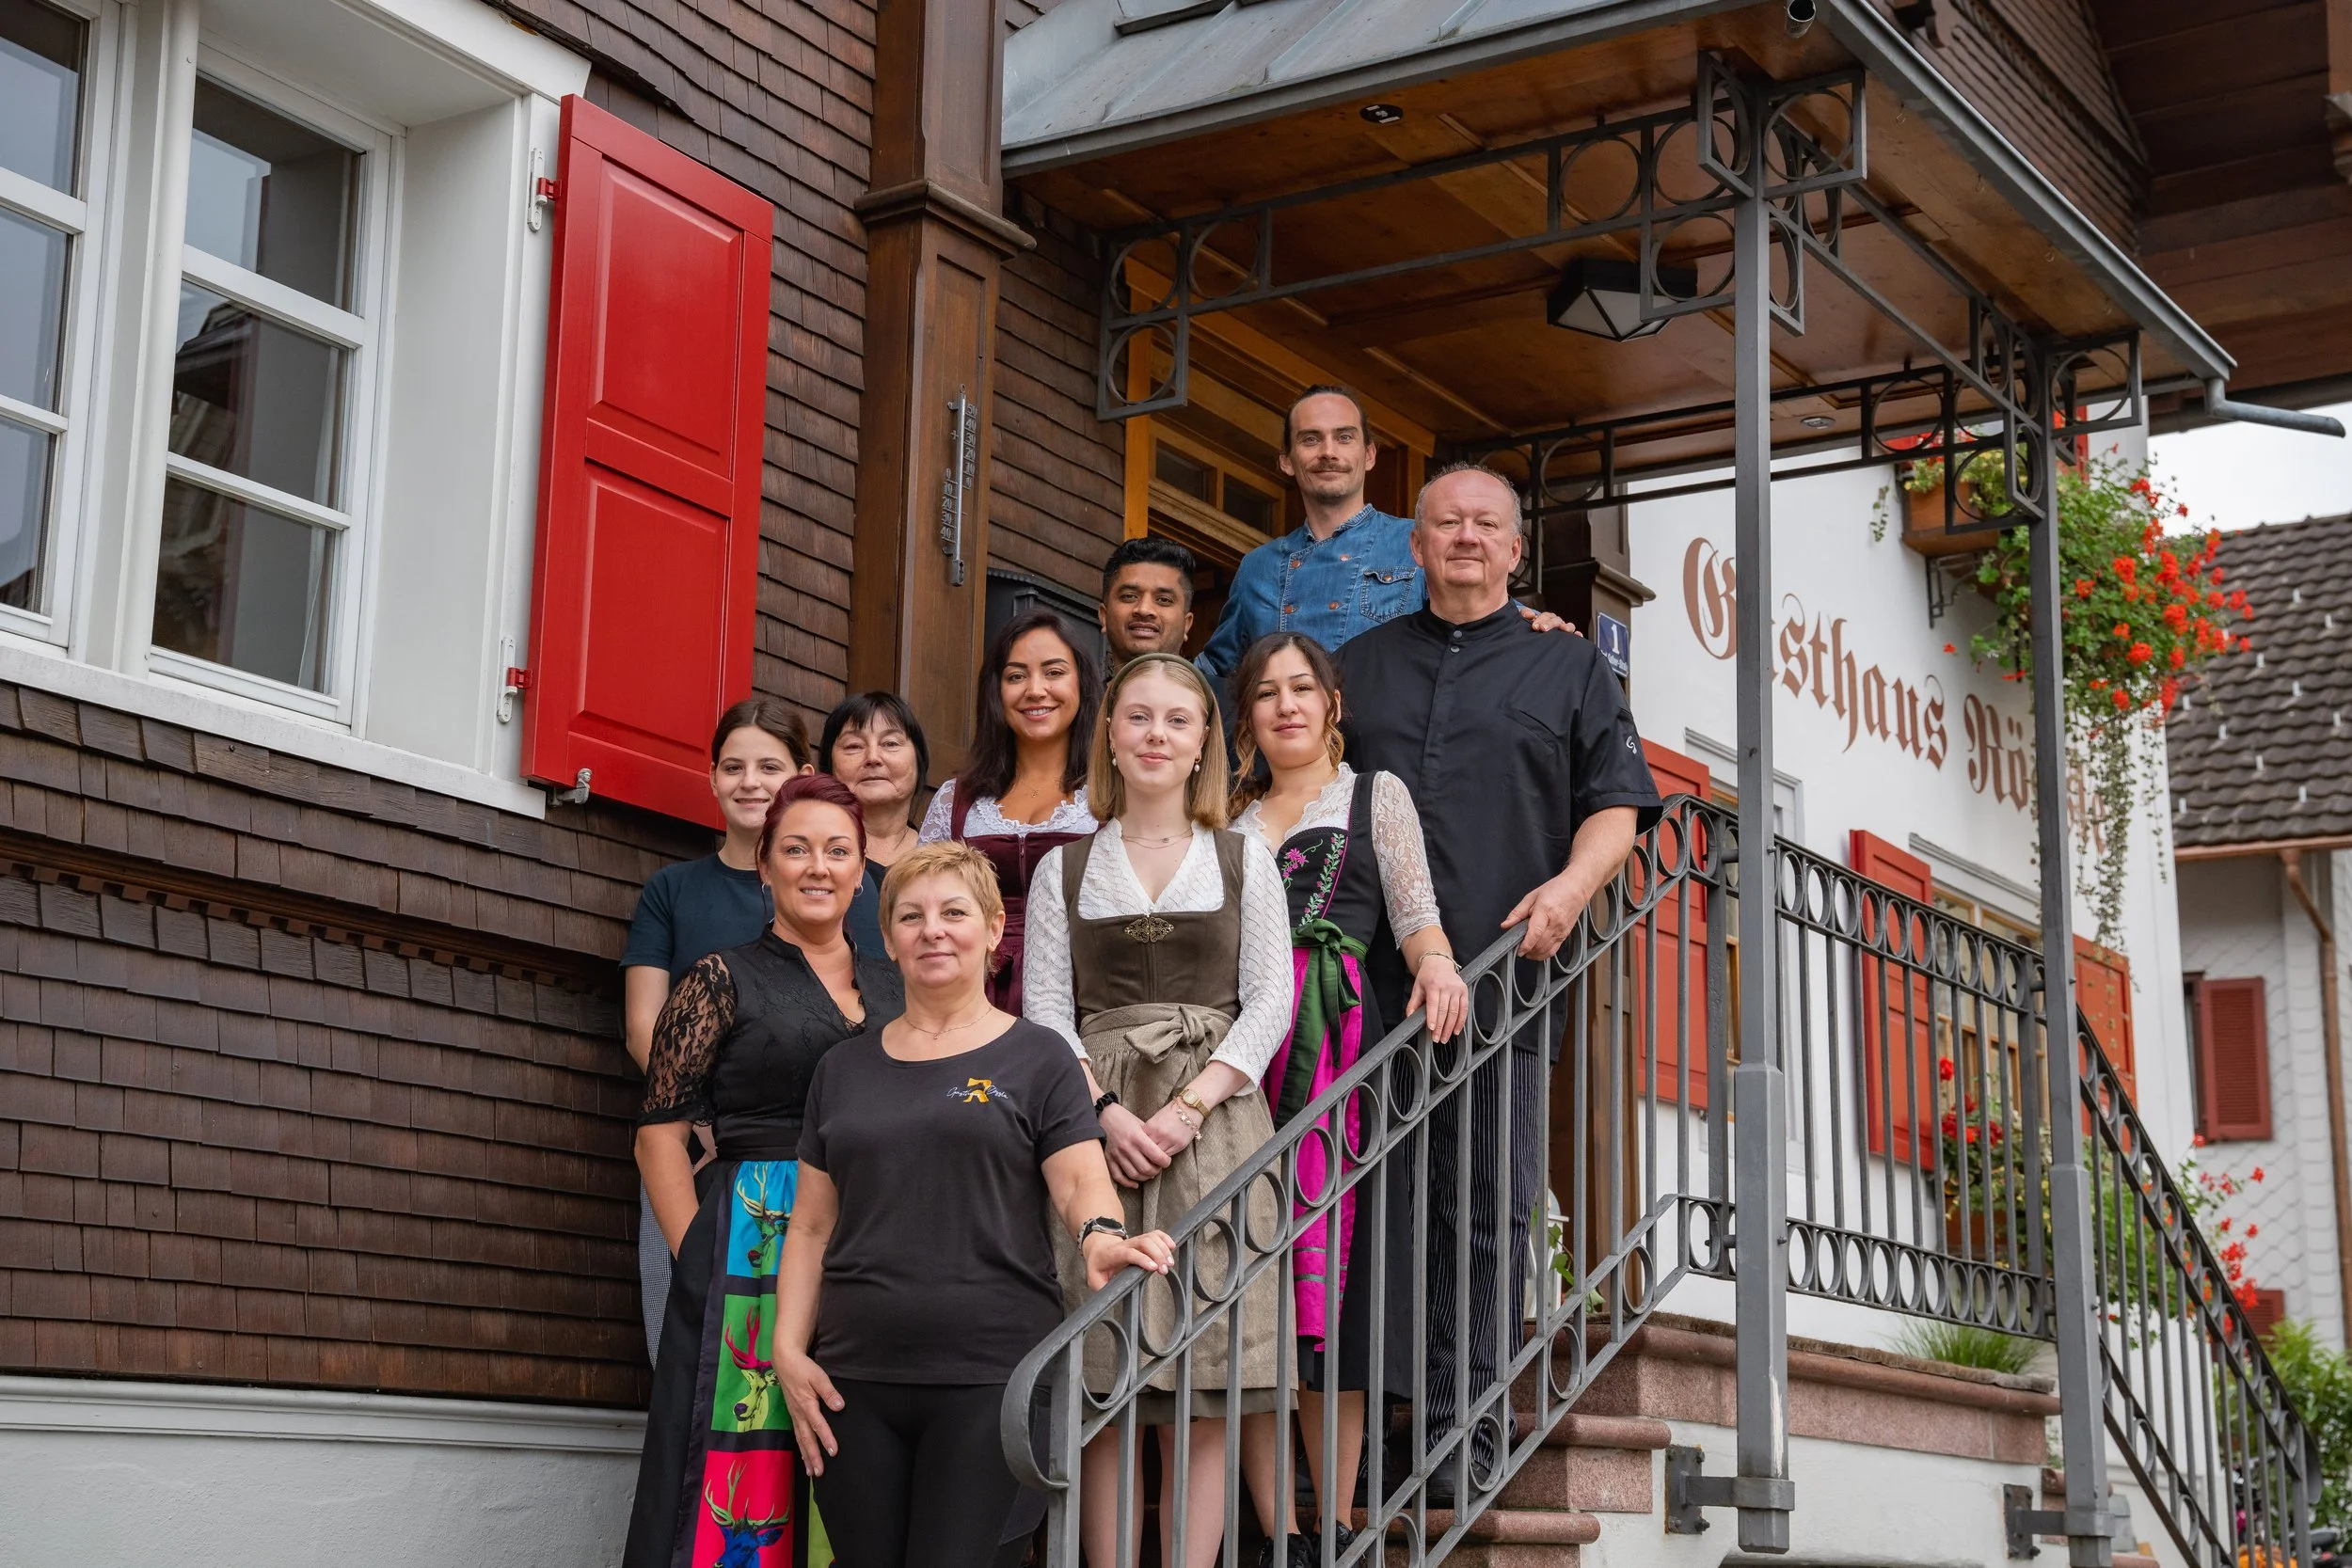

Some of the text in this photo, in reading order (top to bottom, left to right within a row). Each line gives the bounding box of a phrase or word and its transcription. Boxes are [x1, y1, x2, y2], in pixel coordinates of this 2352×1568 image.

[965, 419, 977, 431] 40
[965, 433, 976, 446] 30
[964, 447, 976, 460] 20
[942, 497, 952, 509] 20
[942, 511, 952, 524] 30
[940, 527, 951, 539] 40
[1611, 624, 1620, 655] 1
[1683, 537, 1948, 771] Gsthaus
